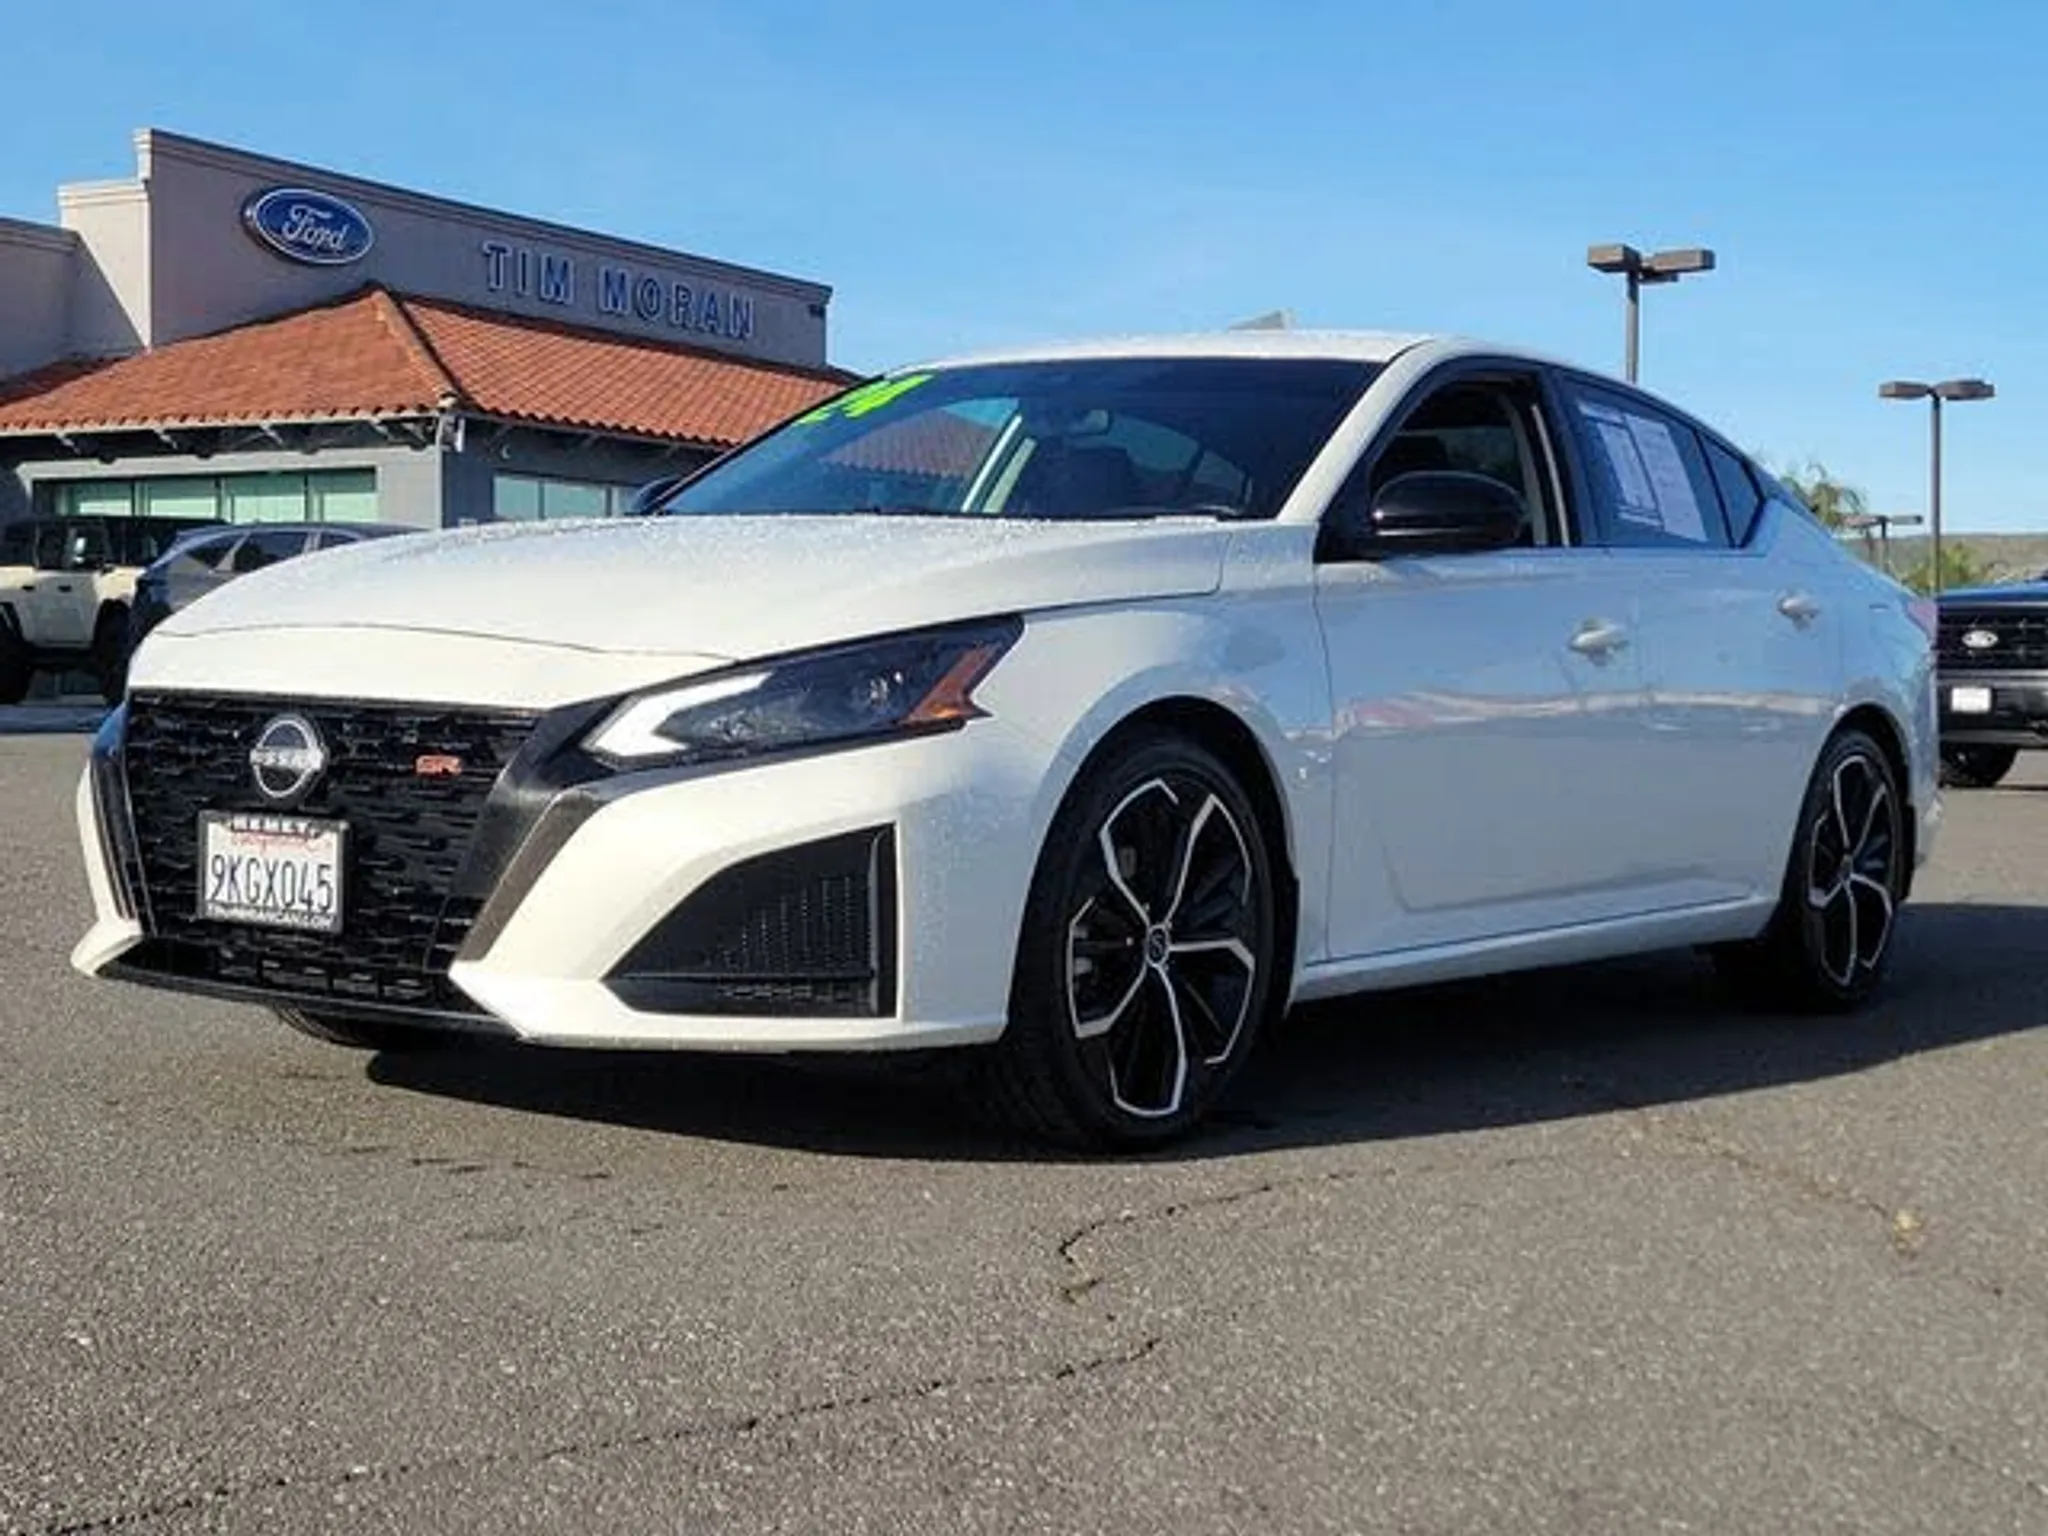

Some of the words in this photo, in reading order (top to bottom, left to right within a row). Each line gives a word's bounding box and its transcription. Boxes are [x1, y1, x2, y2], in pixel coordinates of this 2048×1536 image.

[282, 204, 350, 252] Ford
[484, 240, 574, 305] TIM
[599, 265, 756, 340] MORAN
[210, 854, 334, 916] 9KGX045
